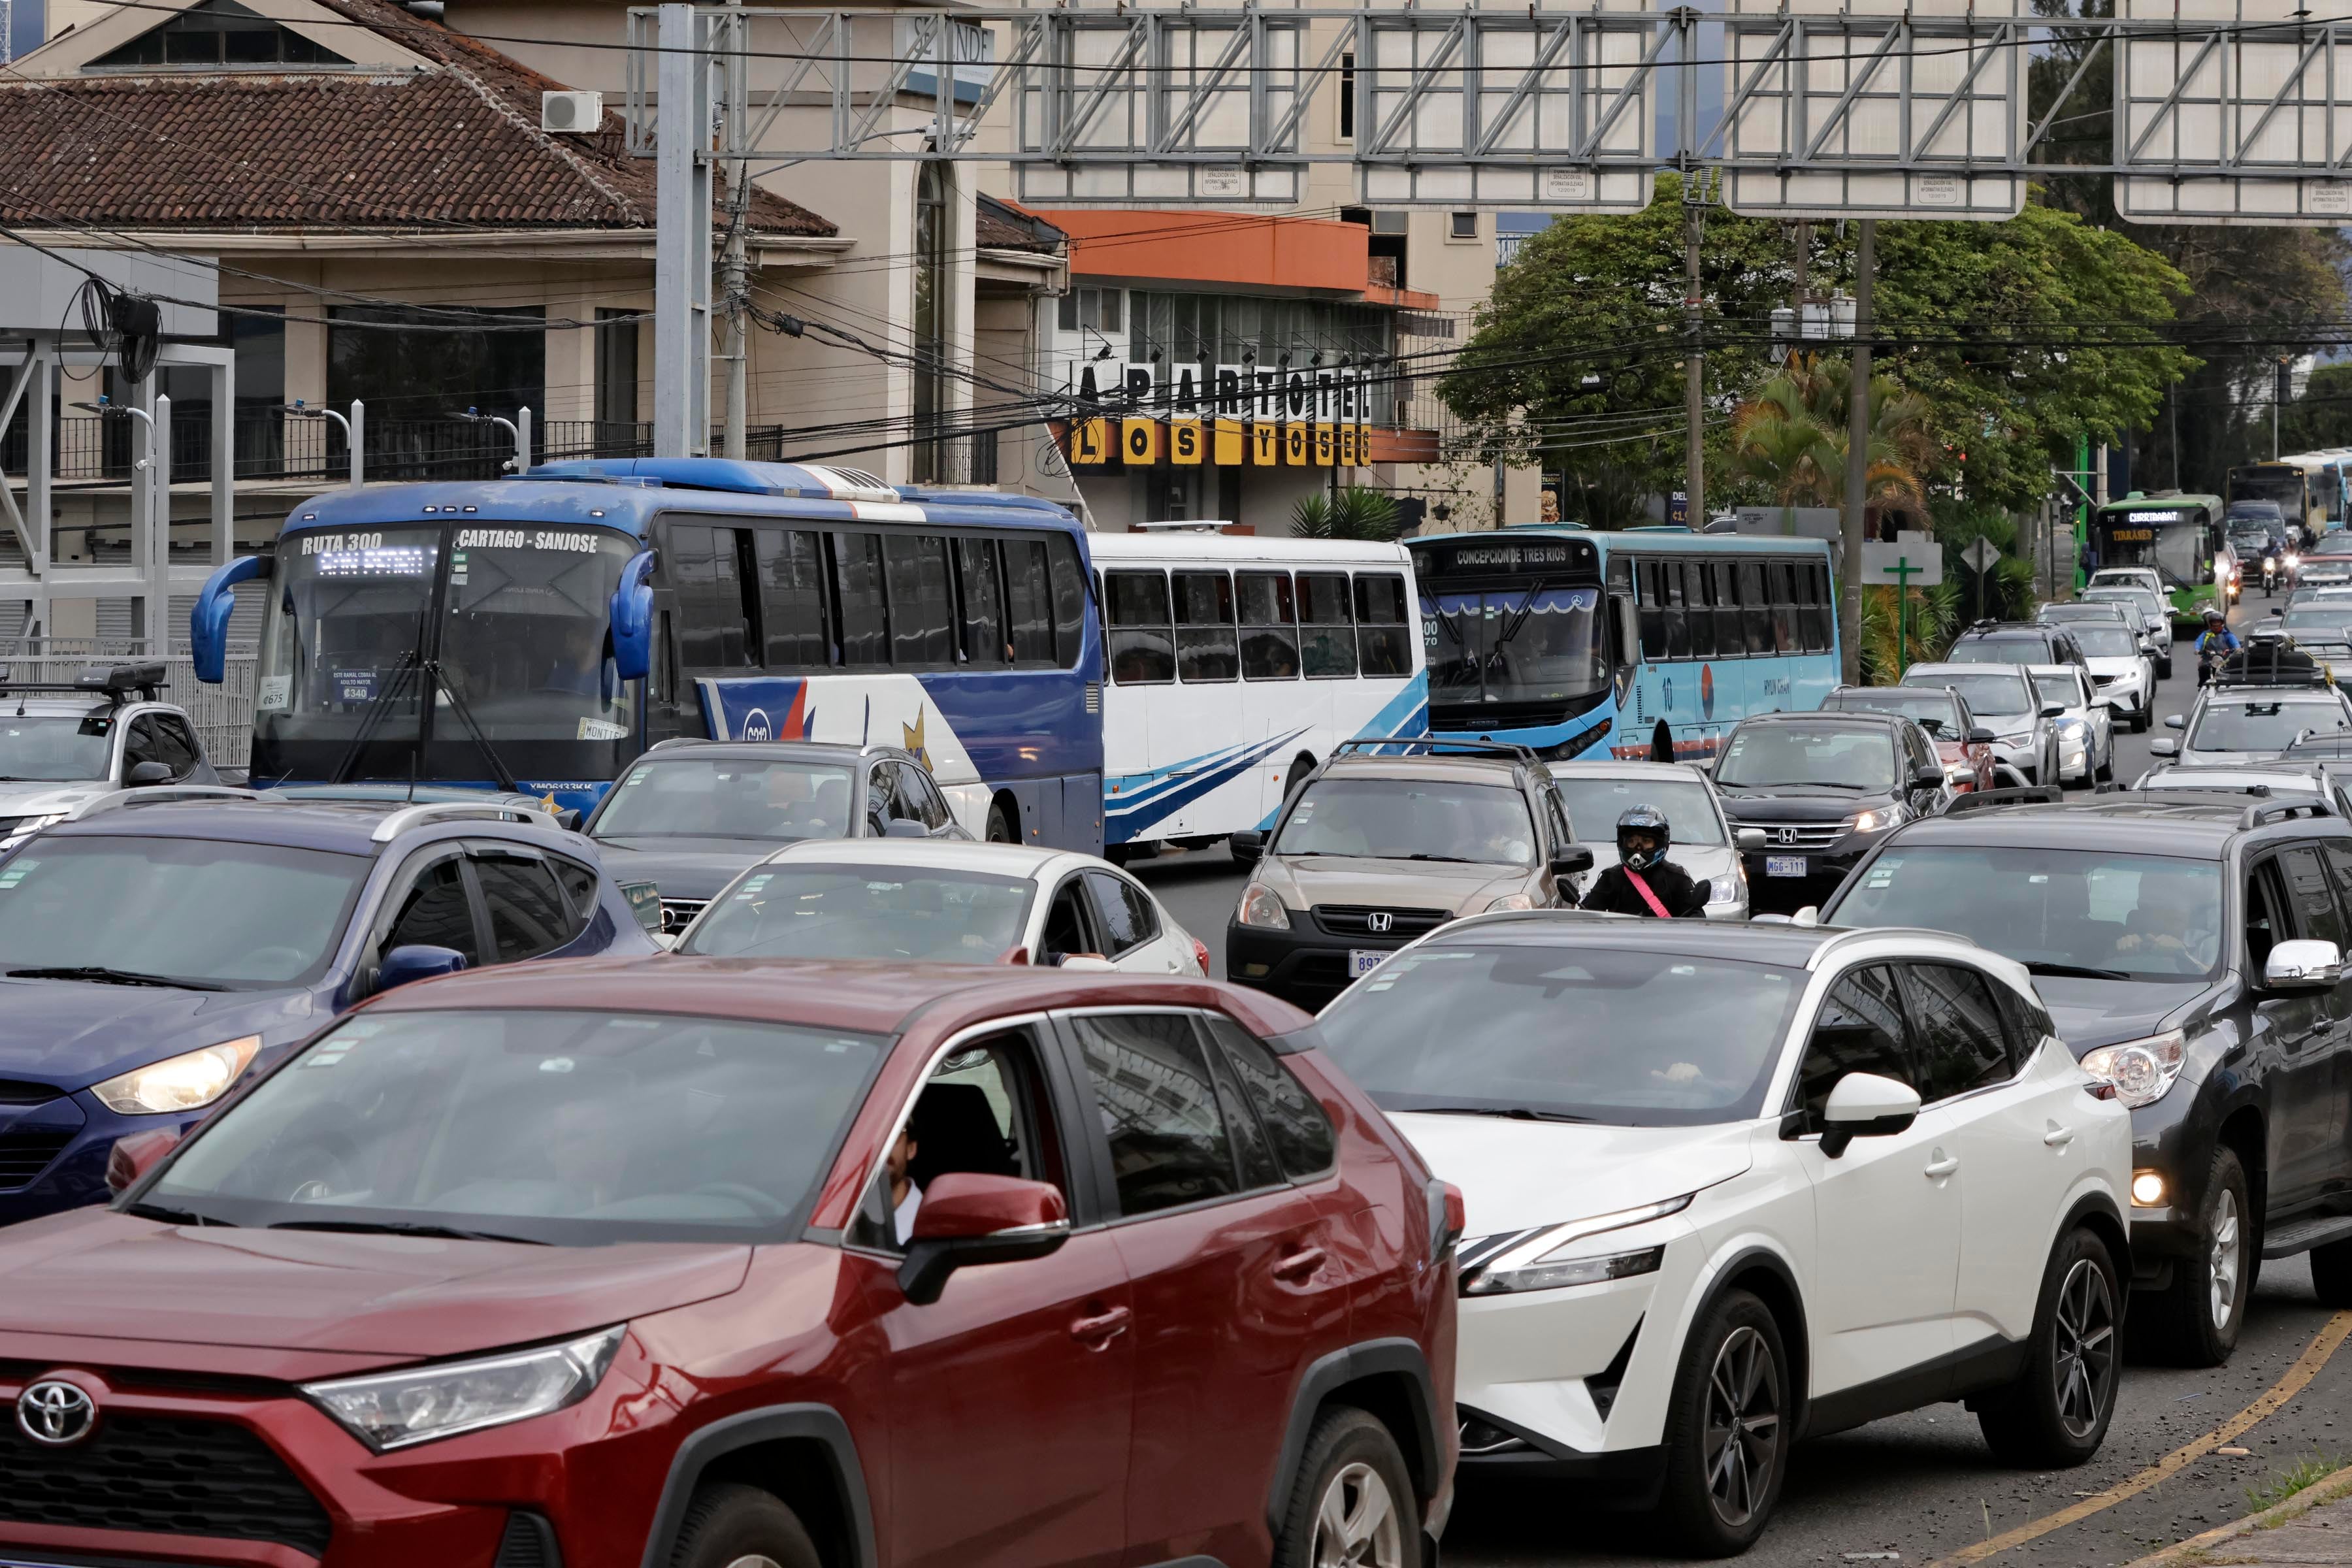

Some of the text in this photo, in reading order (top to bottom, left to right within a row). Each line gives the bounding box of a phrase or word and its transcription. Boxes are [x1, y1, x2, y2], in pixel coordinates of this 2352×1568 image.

[1078, 367, 1370, 418] APARTOTEL
[1081, 427, 1370, 459] LOS YOSES
[2129, 511, 2178, 522] CURRIDABAT
[301, 532, 382, 555] RUTA 300
[459, 529, 525, 548] CARTAGO
[535, 531, 598, 553] SANJOSE
[2113, 529, 2153, 541] TIRRASES
[1457, 547, 1566, 564] CONCEPCION DE TRES RIOS
[1422, 621, 1438, 635] 00
[1663, 677, 1673, 713] 10
[1359, 957, 1385, 972] 897
